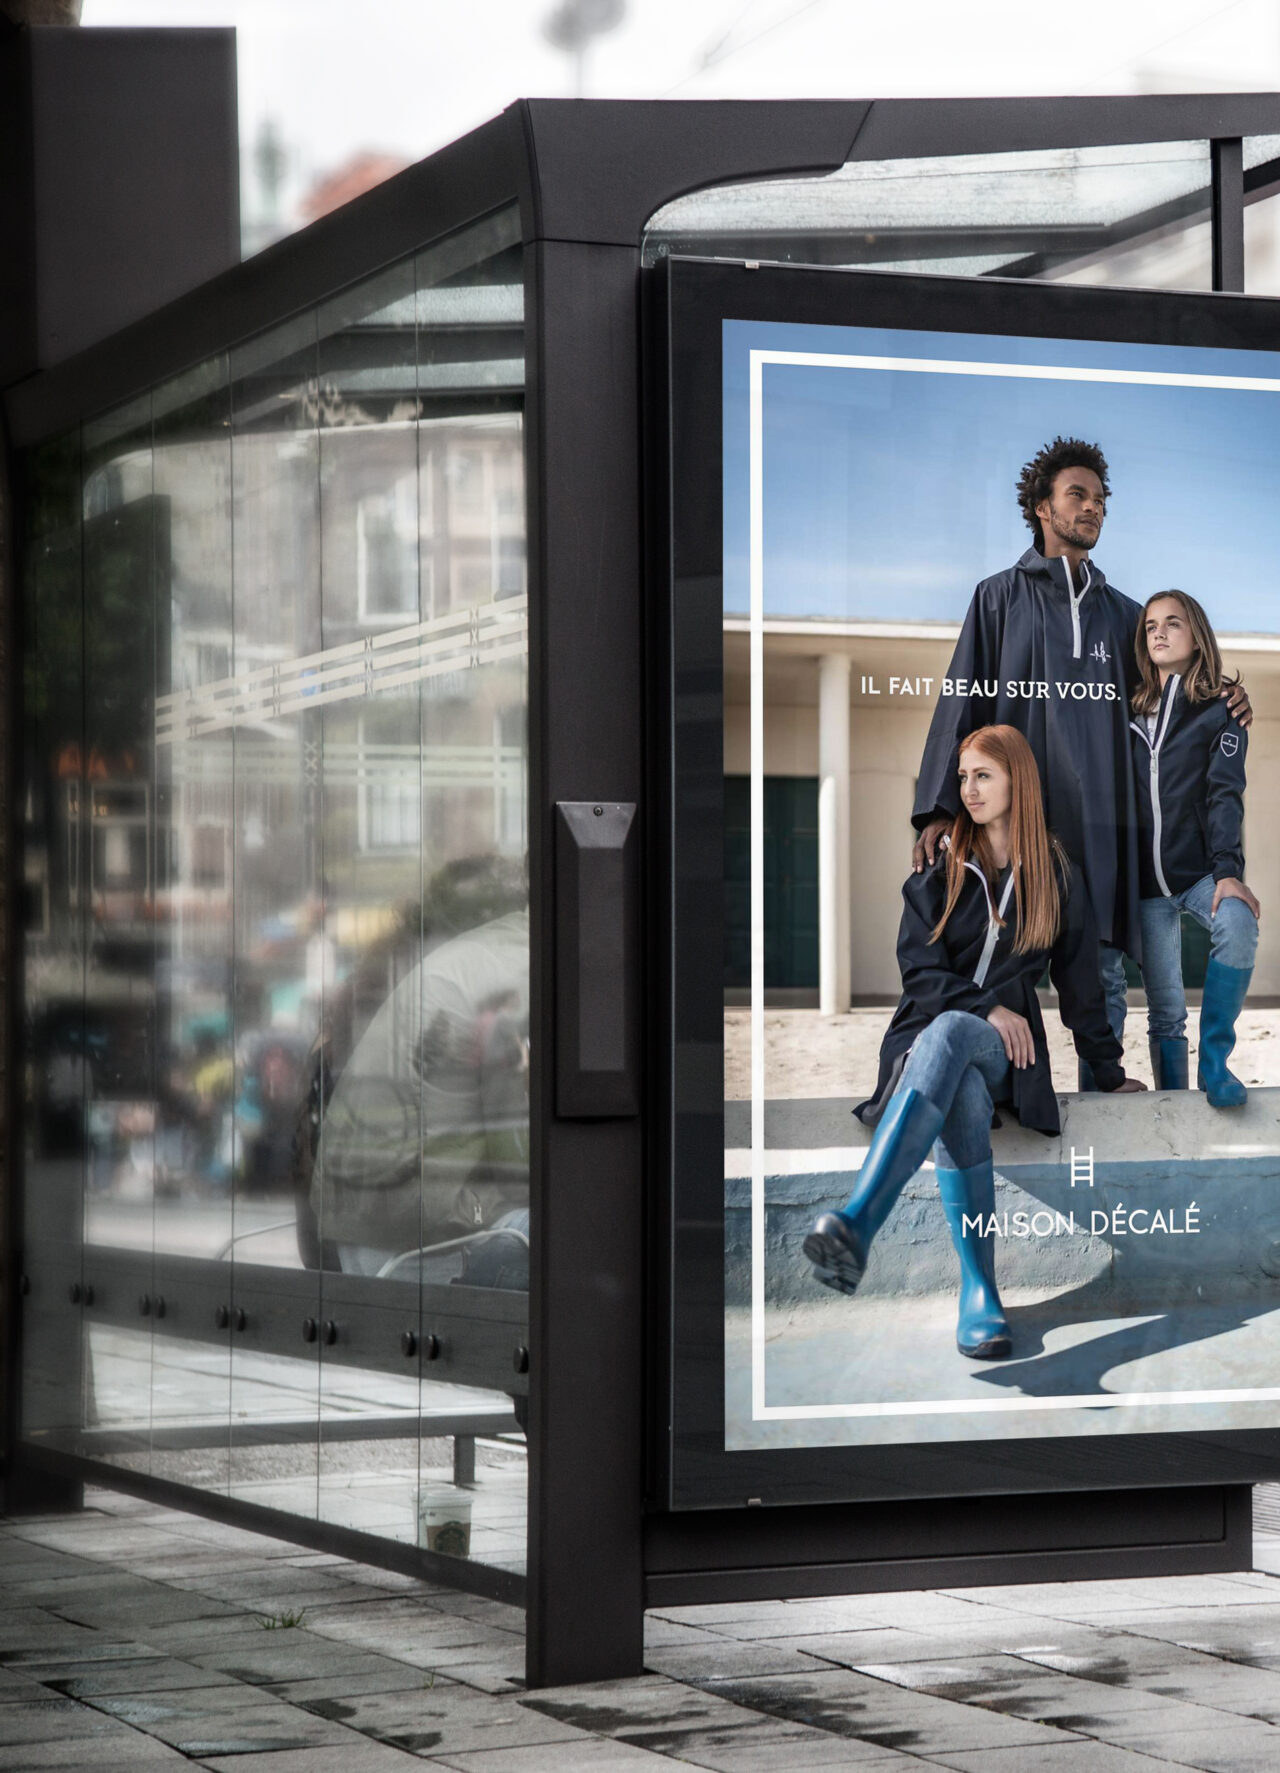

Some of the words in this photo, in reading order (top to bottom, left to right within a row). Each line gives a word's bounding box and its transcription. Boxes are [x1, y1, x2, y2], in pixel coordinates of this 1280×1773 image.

[861, 676, 881, 695] IL
[888, 677, 934, 696] FAIT
[942, 678, 998, 698] BEAU
[1006, 680, 1051, 699] SUR
[1055, 682, 1122, 701] VOUS.
[961, 1211, 1075, 1238] MAISON
[1090, 1201, 1201, 1236] DÉCALÉ
